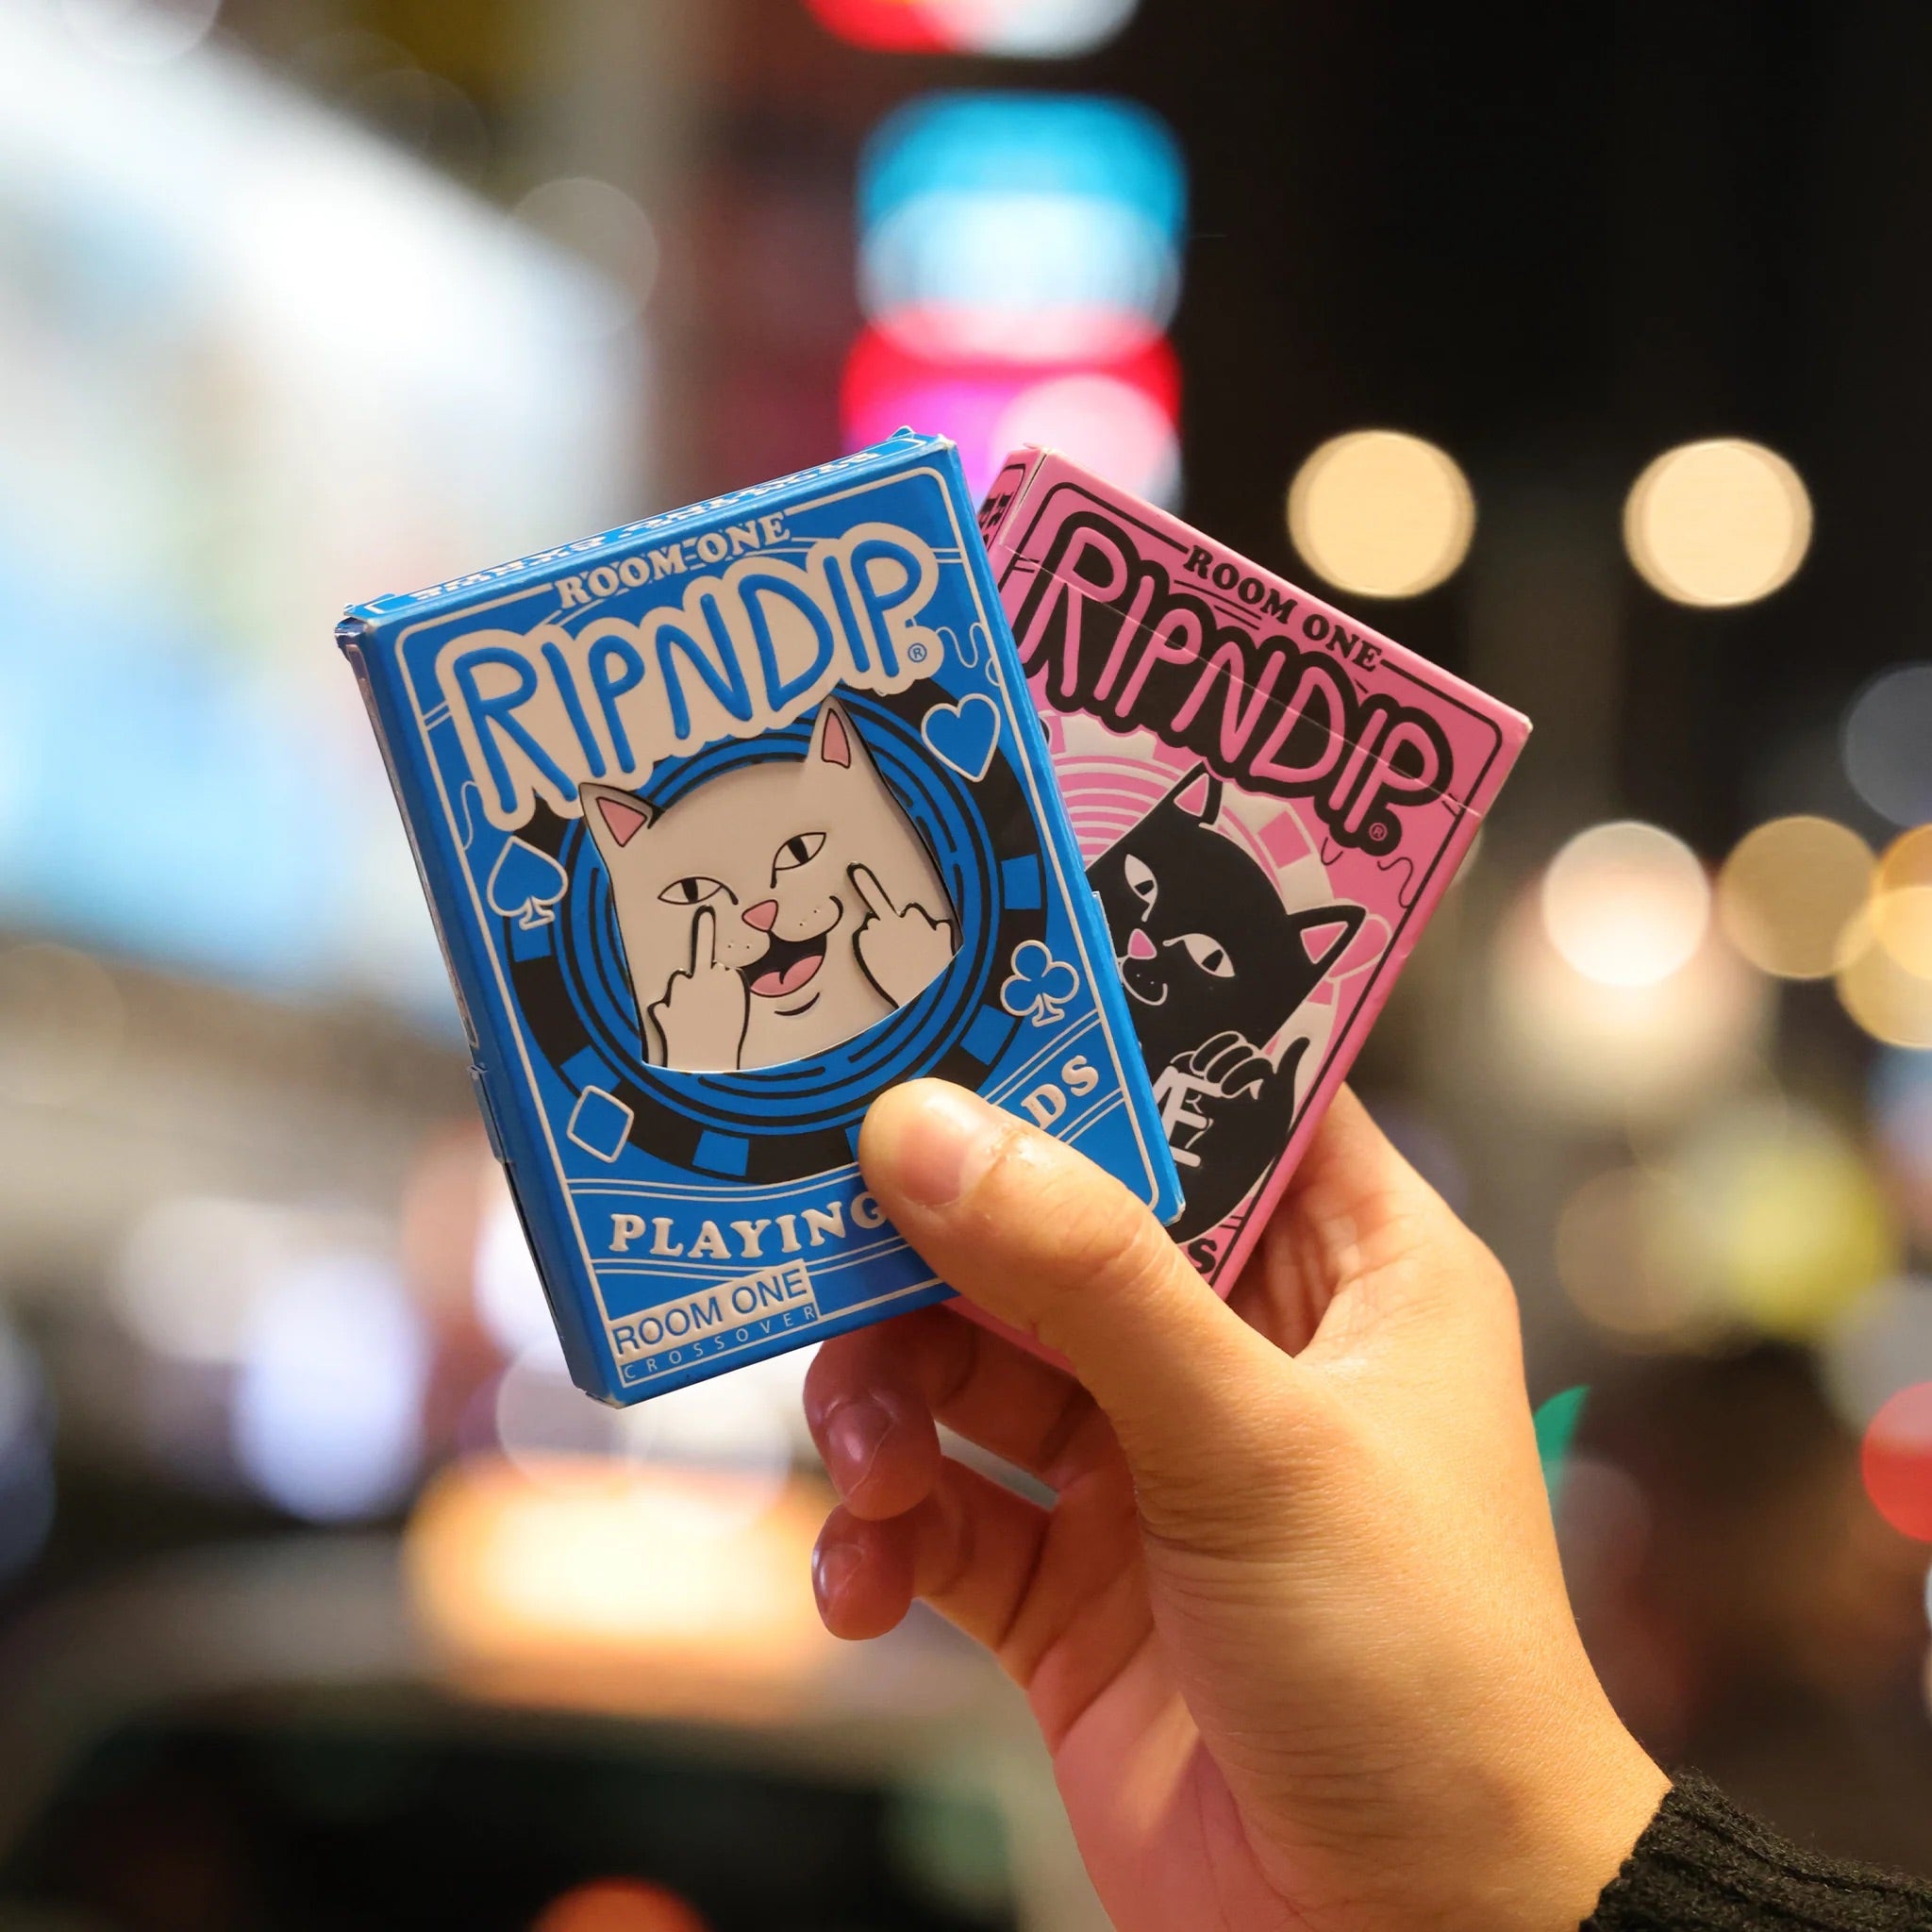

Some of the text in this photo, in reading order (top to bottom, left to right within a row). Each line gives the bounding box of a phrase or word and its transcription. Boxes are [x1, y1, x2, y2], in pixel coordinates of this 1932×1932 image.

[555, 543, 689, 609] ROOM
[696, 510, 791, 563] ONE
[1183, 544, 1383, 673] ROOM ONE
[609, 1191, 886, 1260] PLAYING
[611, 1267, 808, 1356] ROOM ONE
[624, 1305, 816, 1380] CROSSOVER
